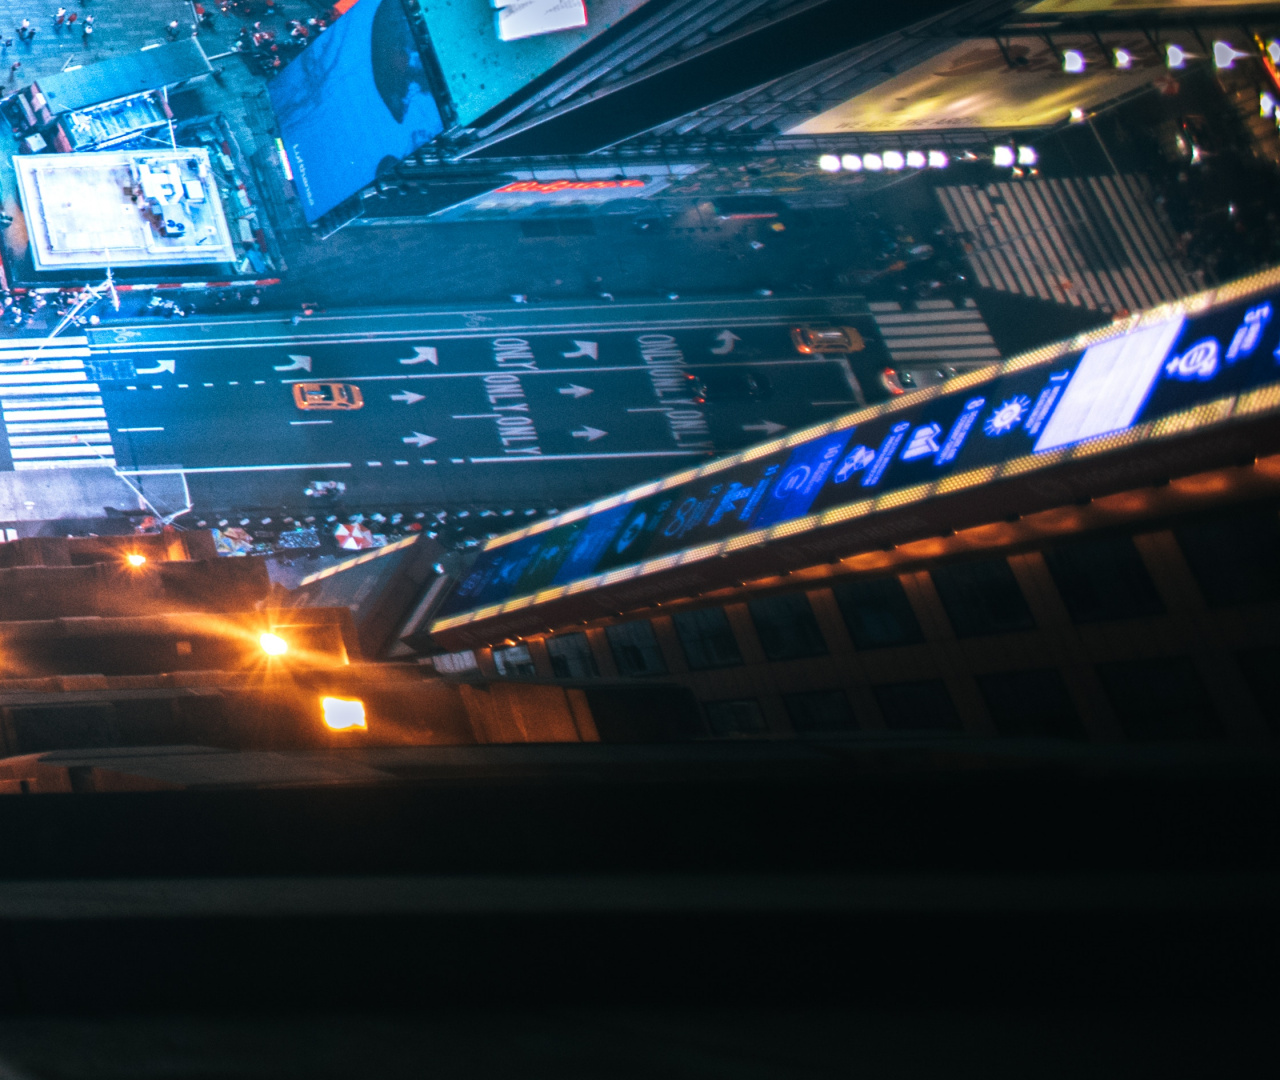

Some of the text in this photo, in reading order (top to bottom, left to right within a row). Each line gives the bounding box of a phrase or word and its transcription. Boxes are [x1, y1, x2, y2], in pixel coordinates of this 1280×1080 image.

[493, 338, 539, 370] ONLY
[638, 334, 687, 365] ONLY
[484, 374, 529, 412] ONLY
[496, 416, 542, 455] ONLY
[666, 410, 715, 449] ONLY
